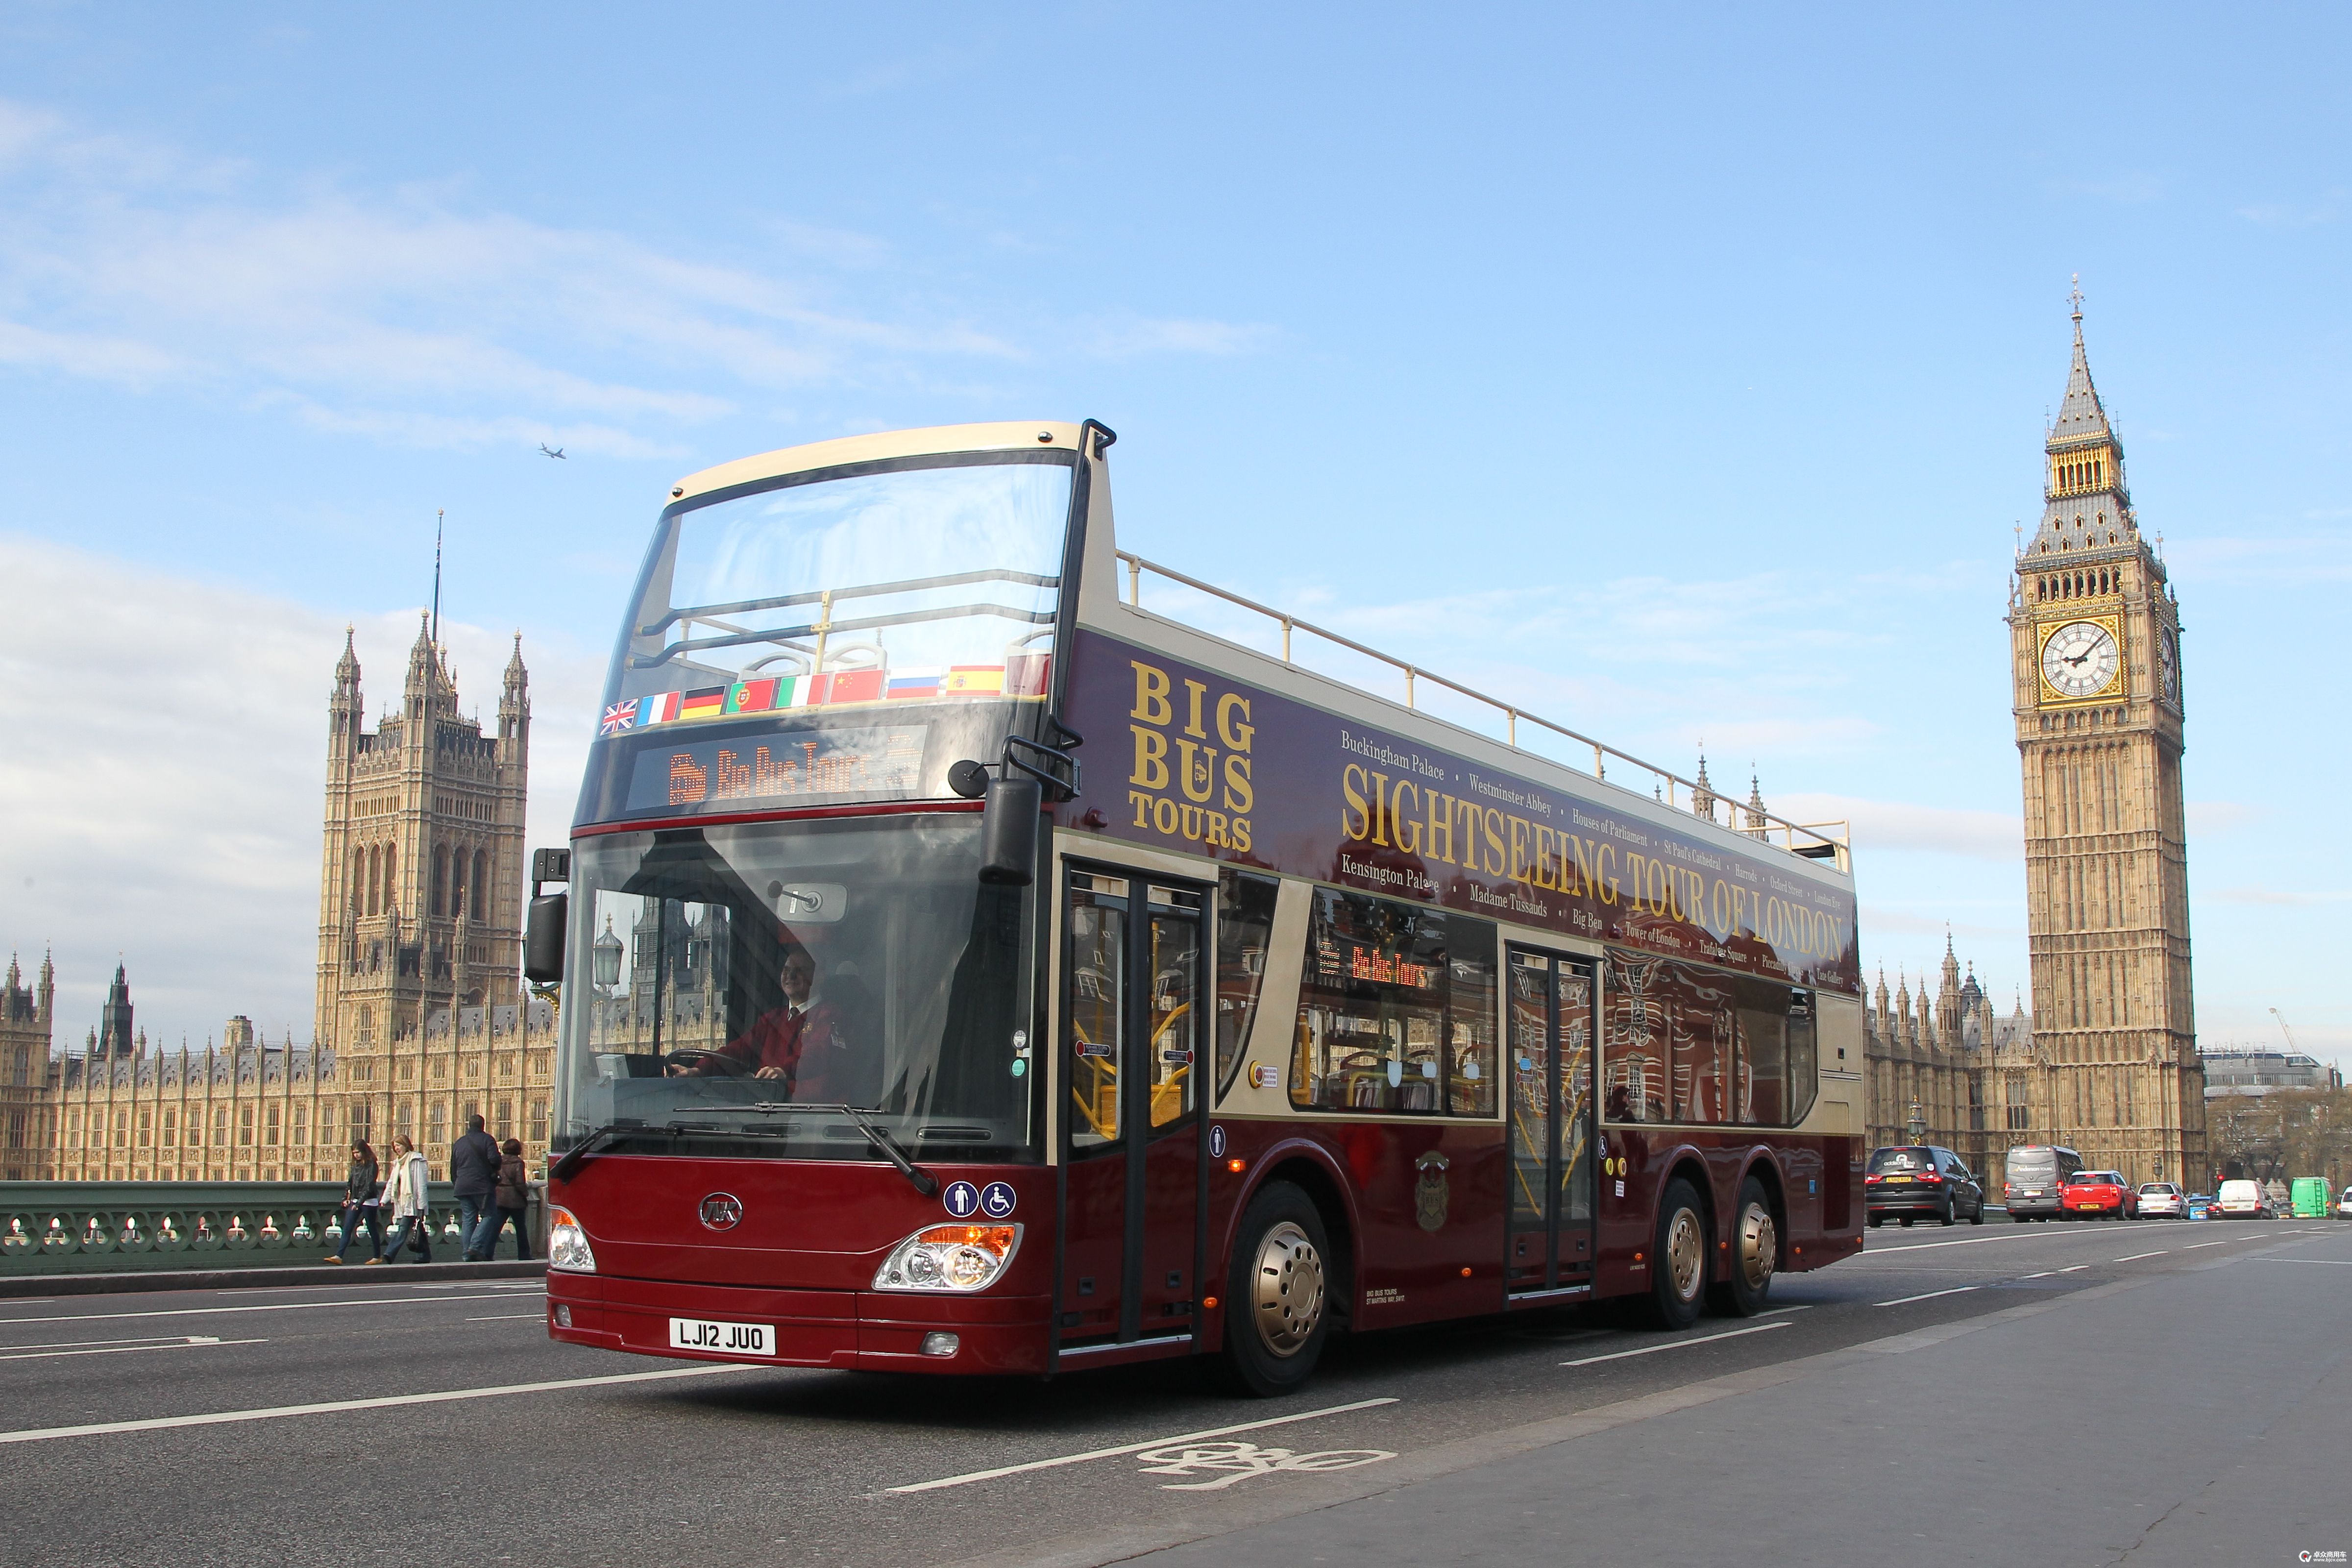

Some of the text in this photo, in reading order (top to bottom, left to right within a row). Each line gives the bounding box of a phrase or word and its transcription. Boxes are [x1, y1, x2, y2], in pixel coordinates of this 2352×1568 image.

[1130, 660, 1255, 754] BIG
[718, 741, 873, 799] Big Bus Tours
[1129, 724, 1254, 814] BUS
[1129, 790, 1251, 853] TOURS
[1341, 730, 1410, 766] Buckingham
[1412, 754, 1445, 781] Palace
[1469, 773, 1524, 806] Westminster
[1526, 792, 1552, 818] Abbey
[1572, 808, 1599, 831] Houses
[1601, 819, 1610, 834] of
[1610, 821, 1648, 847] Parliament
[1664, 839, 1671, 854] St
[1673, 842, 1691, 861] Paul's
[1692, 849, 1721, 871] Cathedral
[1735, 863, 1758, 883] Harrods
[1770, 876, 1788, 893] Oxford
[1788, 882, 1803, 898] Street
[1814, 890, 1832, 907] London
[1343, 763, 1842, 963] SIGHTSEEING TOUR OF LONDON
[1342, 853, 1403, 885] Kensington
[1470, 883, 1508, 908] Madame
[1509, 893, 1547, 917] Tussauds
[1572, 908, 1586, 930] Big
[1588, 912, 1603, 930] Ben
[1625, 921, 1647, 941] Tower
[1648, 928, 1656, 942] of
[1656, 929, 1680, 948] London
[1727, 945, 1747, 963] Square
[1762, 954, 1788, 974] Piccadilly
[1827, 969, 1843, 987] Gallery
[1352, 946, 1425, 988] Big Bus Tours
[680, 1323, 762, 1349] LJ12 JUO
